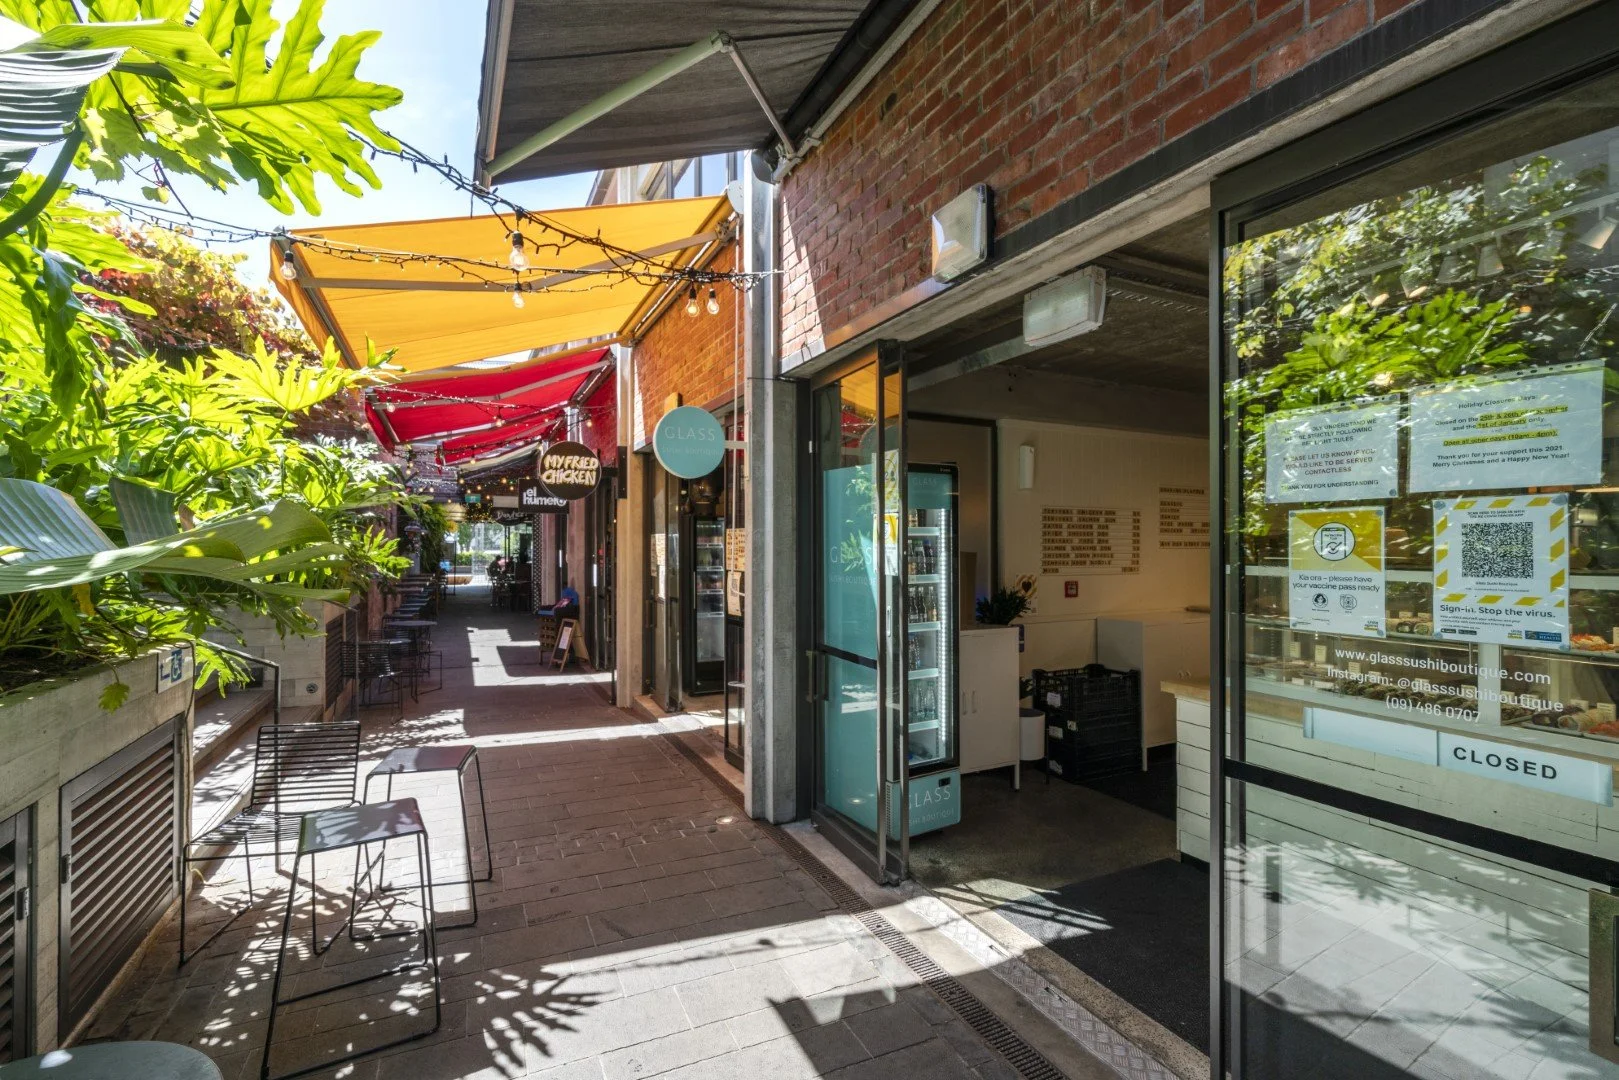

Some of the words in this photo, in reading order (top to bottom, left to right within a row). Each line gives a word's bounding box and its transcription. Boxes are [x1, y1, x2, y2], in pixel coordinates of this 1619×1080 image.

[1324, 420, 1366, 430] UNDERSTAND
[665, 426, 716, 442] GLASS
[1308, 430, 1334, 440] STRICTLY
[1336, 426, 1372, 436] FOLLOWING
[1346, 456, 1373, 464] SERVED
[1304, 466, 1352, 476] CONTACTLESS
[1327, 480, 1379, 488] UNDERSTANDING
[1358, 584, 1380, 592] ready
[1440, 604, 1476, 614] Sign-in.
[1478, 606, 1501, 616] Stop
[1525, 610, 1556, 618] virus.
[1335, 650, 1551, 684] www.glasssushiboutique.com
[1327, 667, 1393, 686] Instagram:
[1397, 678, 1564, 712] @glasssushiboutique
[1386, 696, 1412, 712] (09)
[1416, 702, 1441, 716] 486
[1446, 706, 1481, 722] 0707
[1453, 746, 1557, 780] CLOSED
